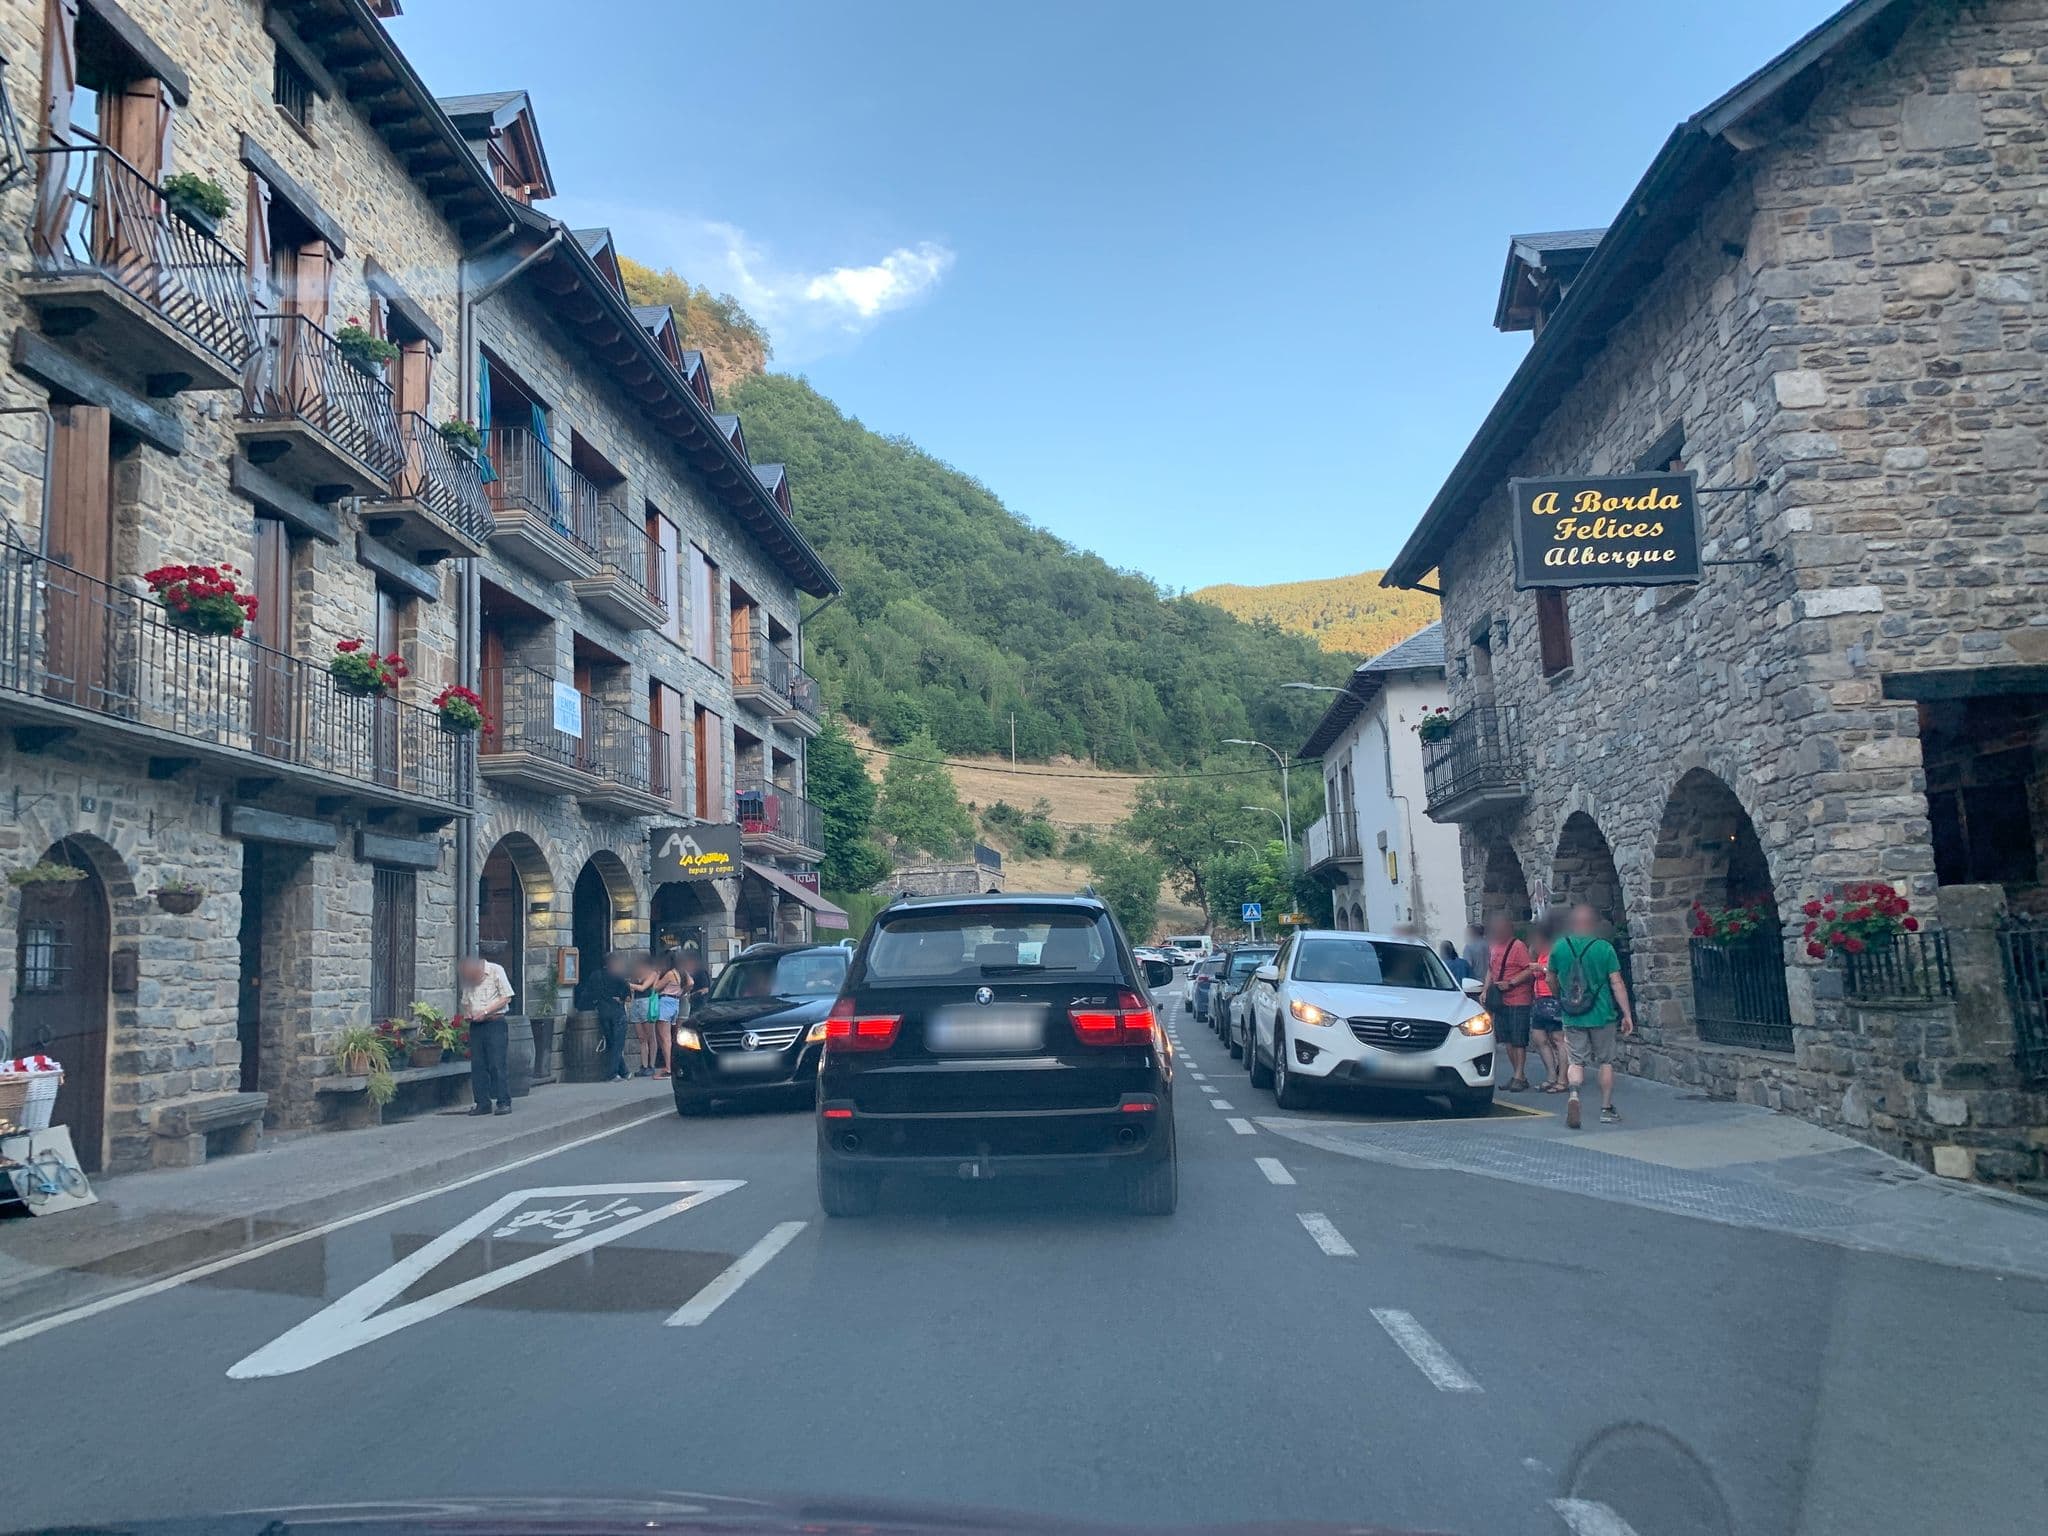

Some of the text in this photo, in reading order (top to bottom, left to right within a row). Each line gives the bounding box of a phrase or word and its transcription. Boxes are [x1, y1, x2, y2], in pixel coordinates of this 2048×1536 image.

[1531, 487, 1683, 515] A Borda
[1553, 516, 1665, 541] Felices
[1543, 546, 1677, 569] Albergue
[679, 854, 693, 866] LA
[1069, 996, 1108, 1006] X5
